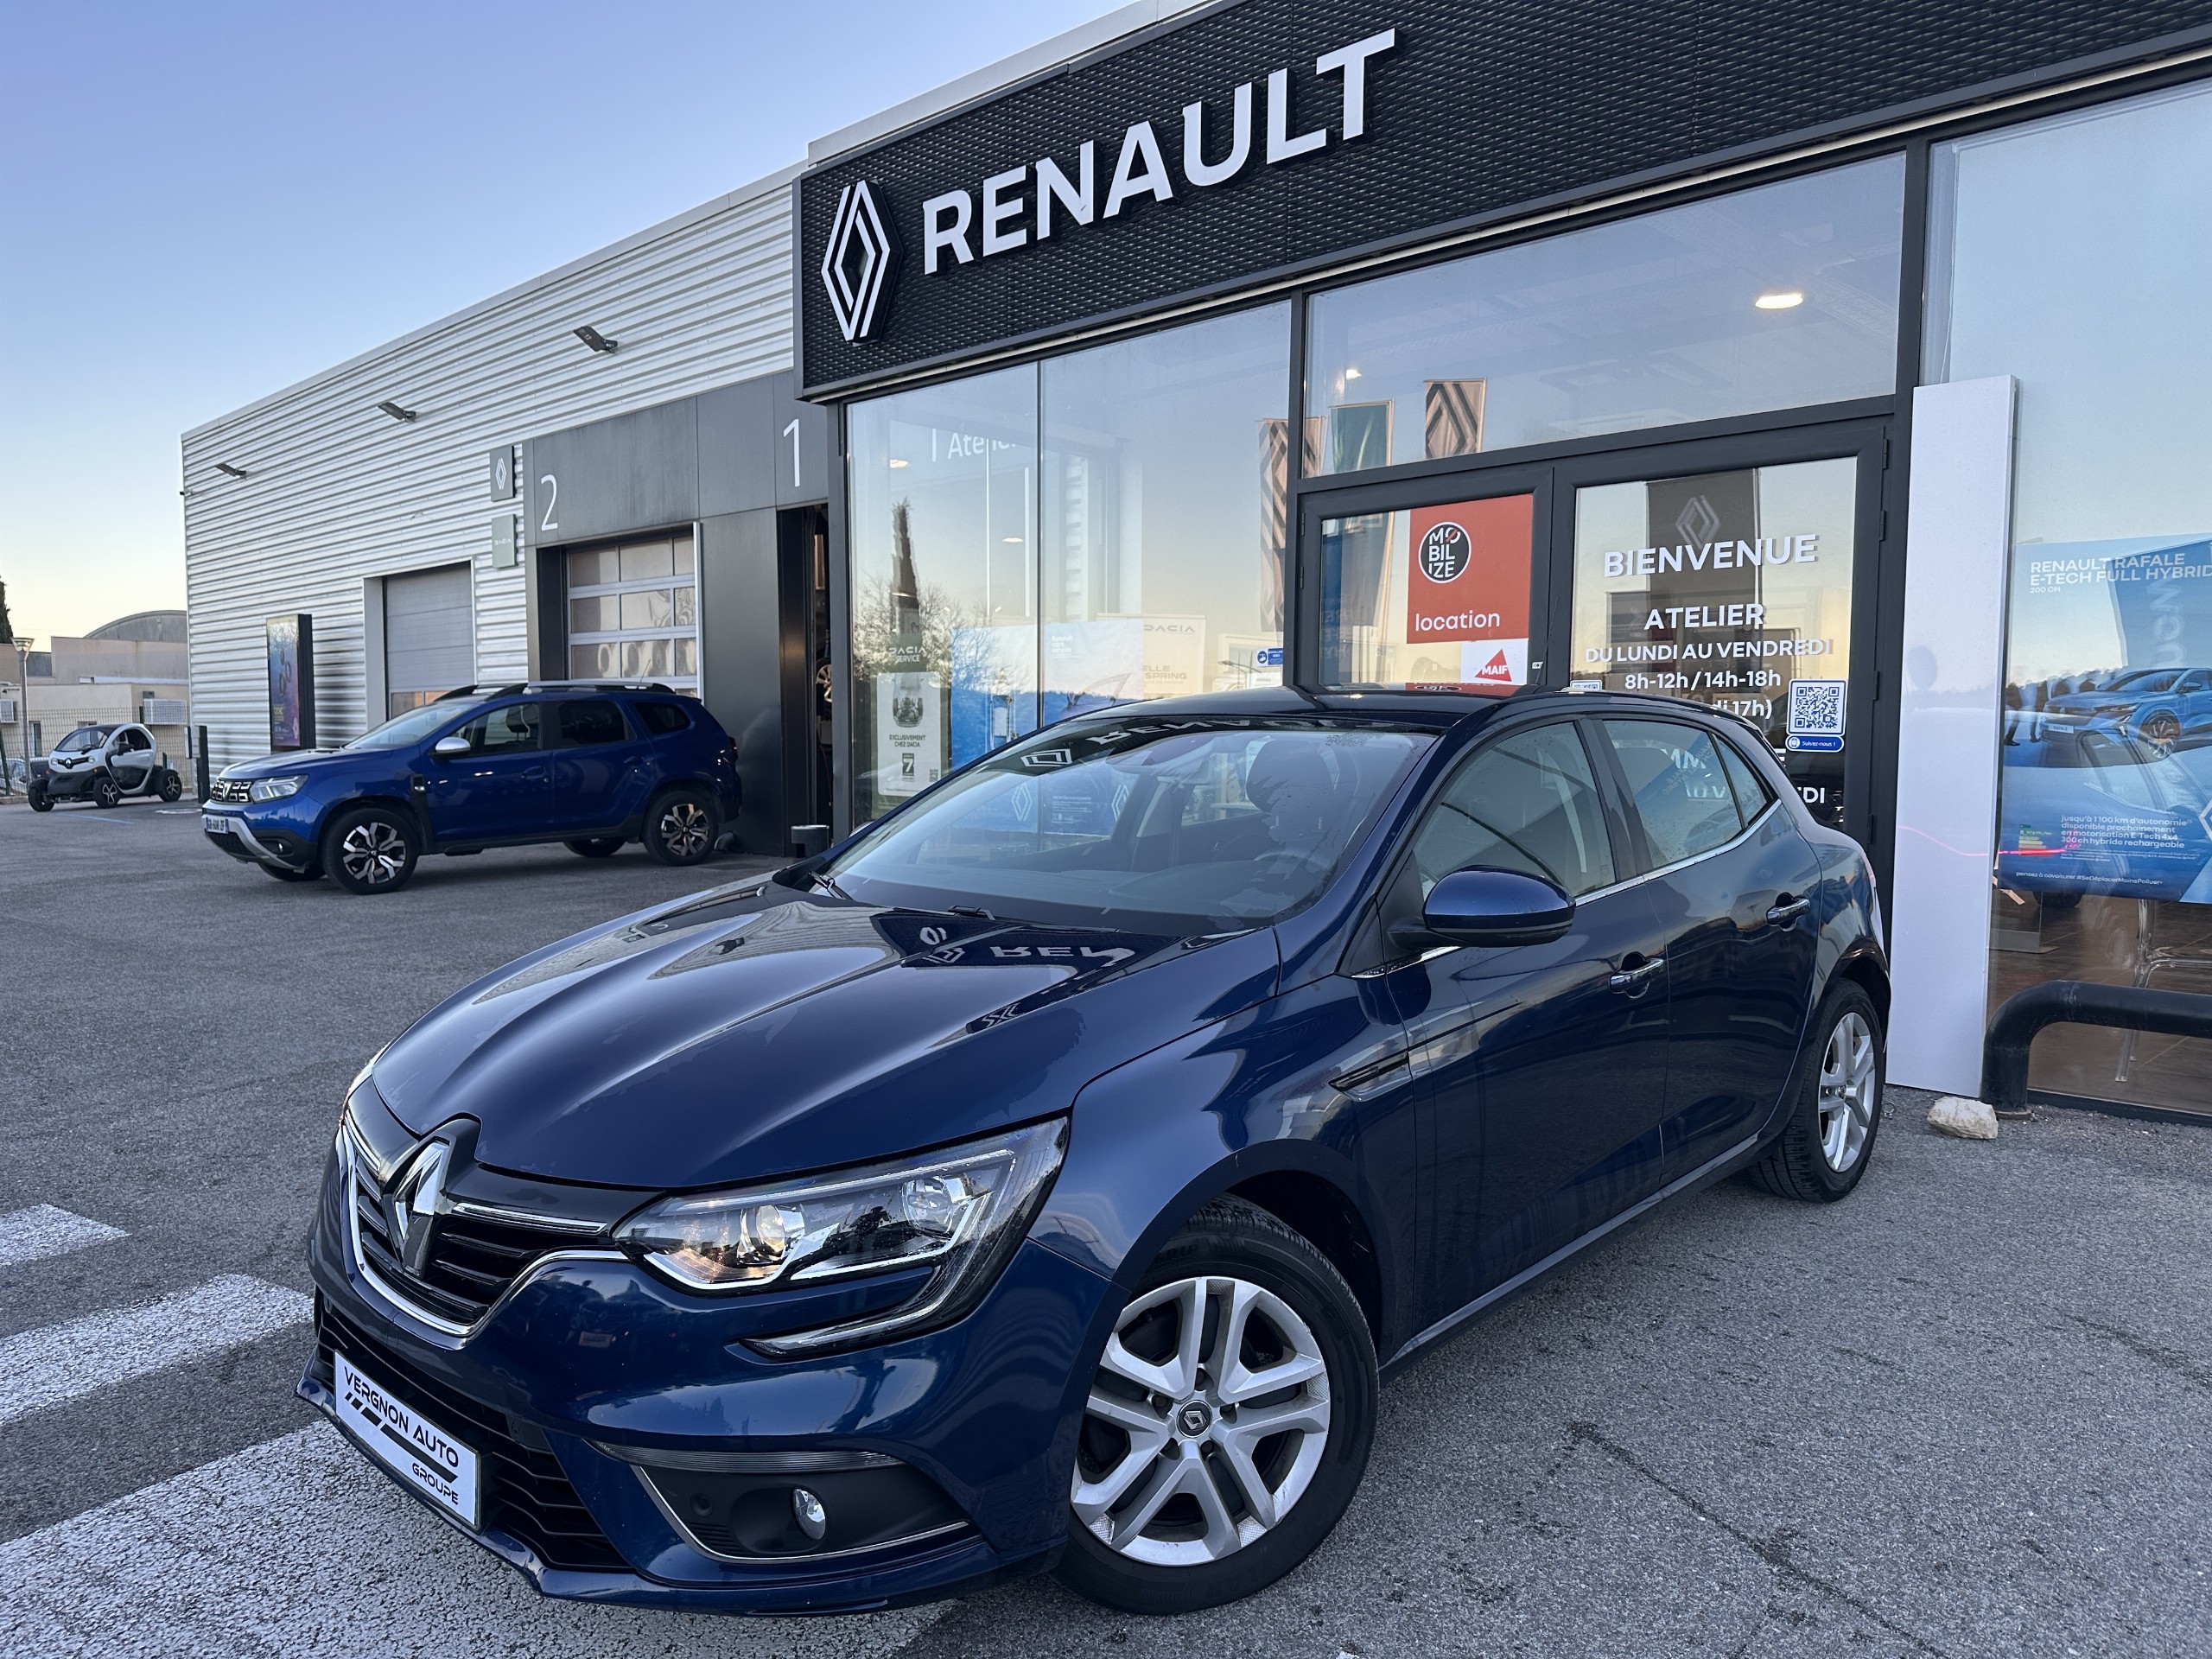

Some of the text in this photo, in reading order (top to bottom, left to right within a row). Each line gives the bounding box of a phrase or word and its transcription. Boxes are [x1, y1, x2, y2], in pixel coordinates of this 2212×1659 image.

[924, 28, 1395, 275] RENAULT
[783, 419, 801, 487] 1
[541, 474, 558, 532] 2
[1604, 534, 1817, 577] BIENVENUE
[2031, 553, 2185, 574] RENAULT RAFALE
[2031, 564, 2212, 587] E-TECH FULL HYBRID
[1415, 610, 1501, 632] location
[1643, 603, 1764, 631] ATELIER
[888, 645, 927, 655] DACIA
[895, 654, 920, 663] SERVICE
[1586, 639, 1831, 664] DU LUNDI AU VENDREDI
[1481, 664, 1509, 676] MAIF
[1624, 673, 1688, 690] 8h-12h
[1704, 670, 1781, 688] 14h-18h
[1732, 699, 1772, 720] 17h)
[2107, 825, 2176, 834] prochainement
[2130, 817, 2188, 826] d'autonomie
[2124, 840, 2185, 849] rechargeable
[344, 1365, 459, 1468] VERGNON AUTO
[411, 1462, 459, 1505] GROUPE
